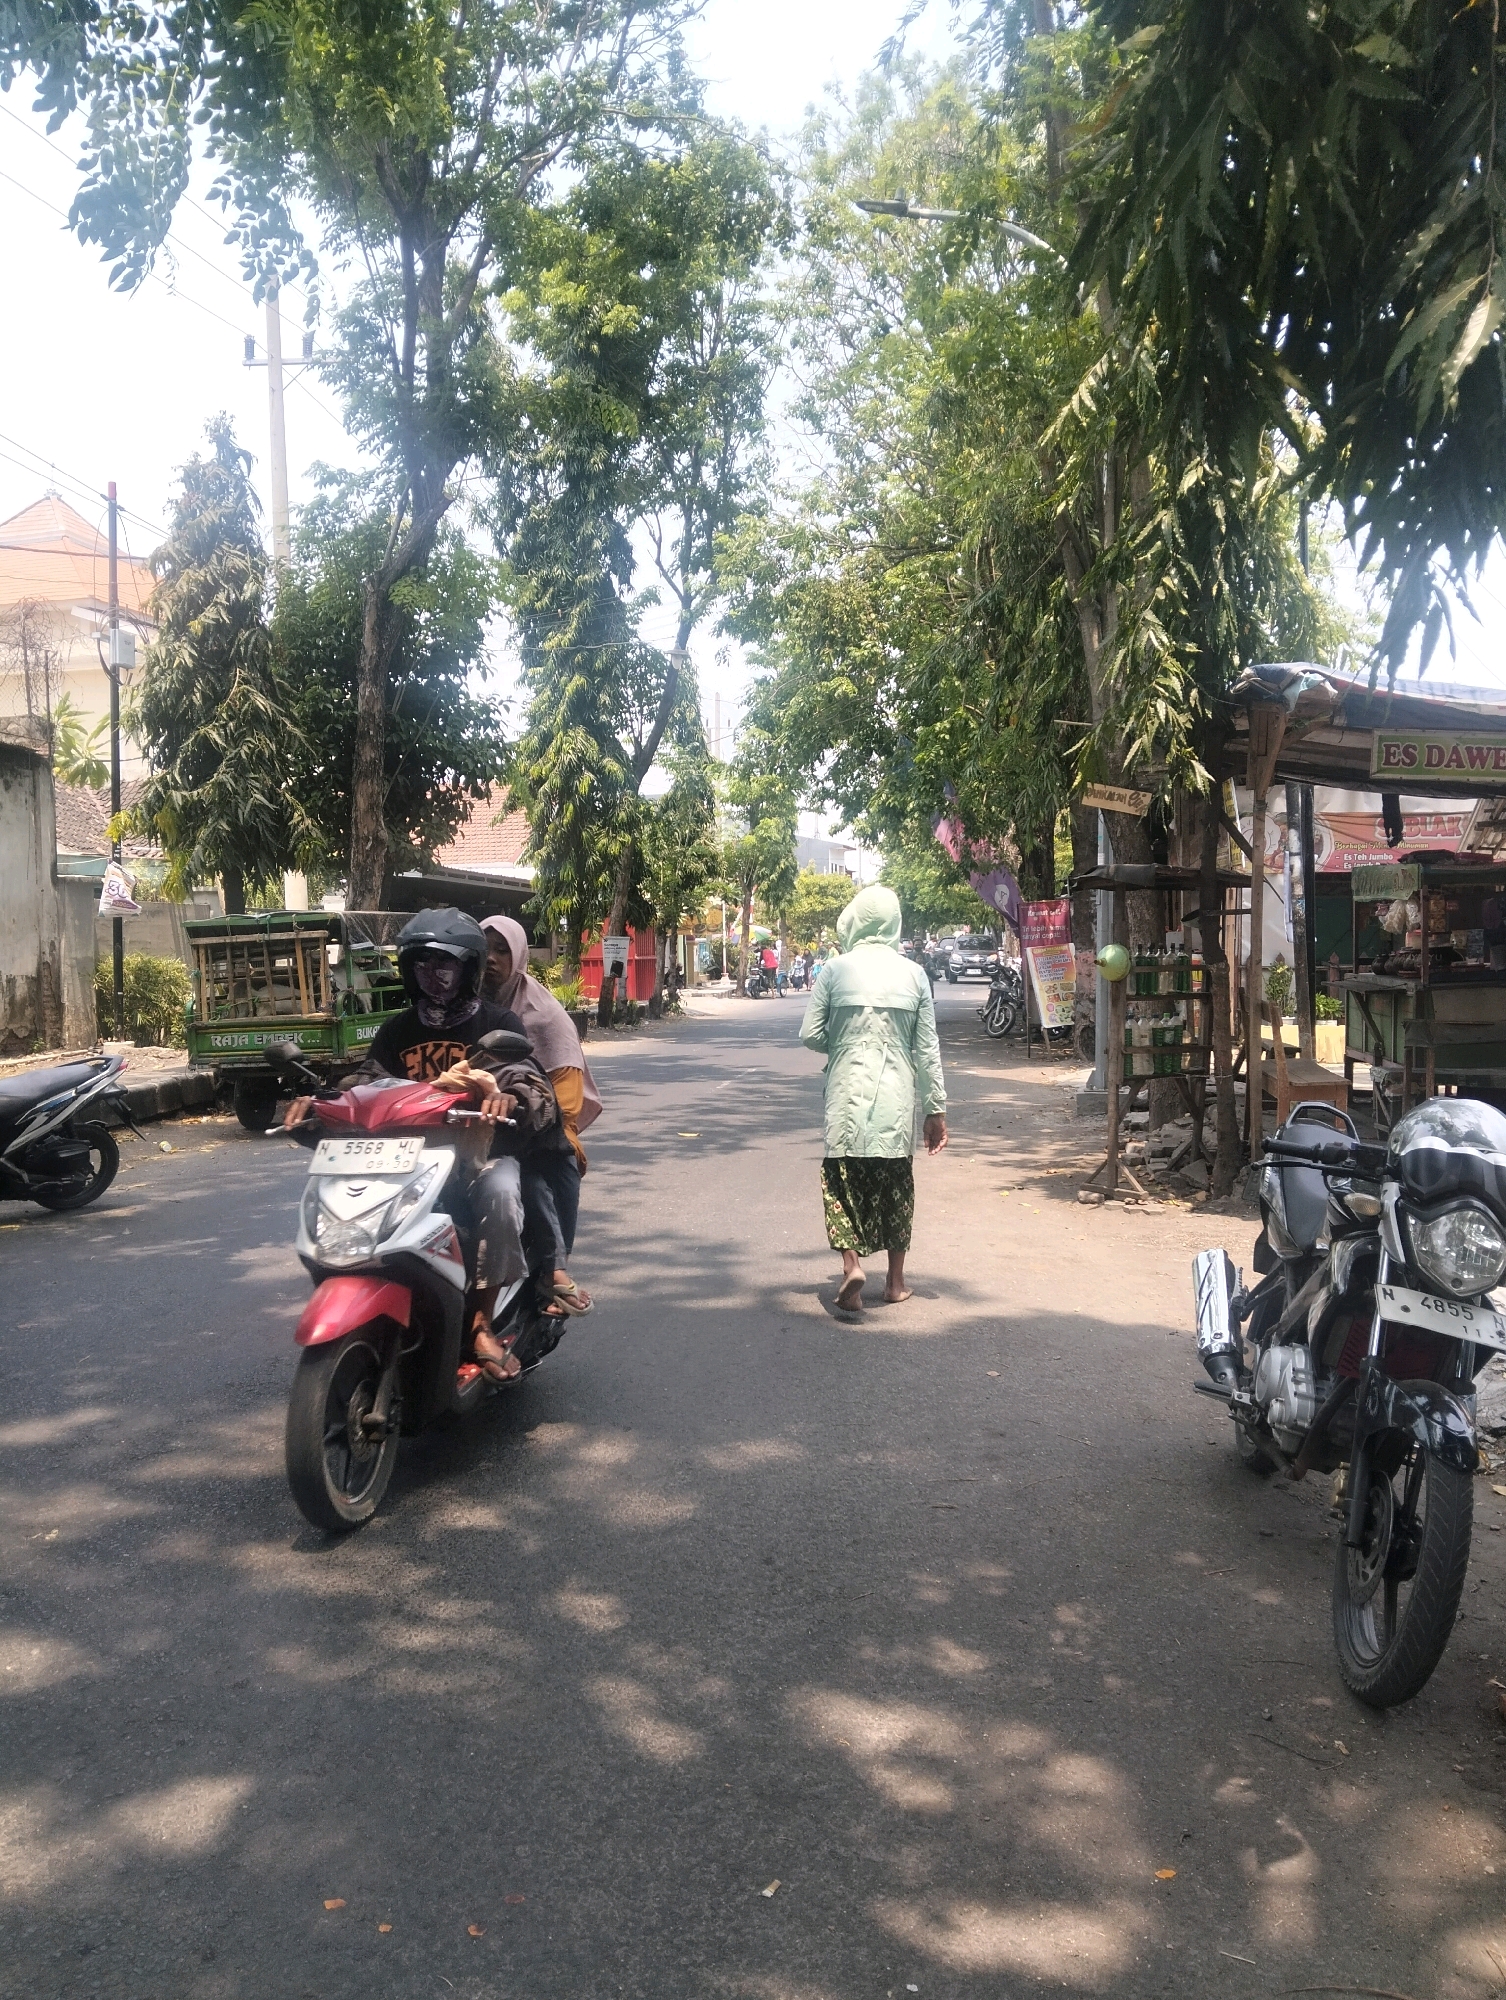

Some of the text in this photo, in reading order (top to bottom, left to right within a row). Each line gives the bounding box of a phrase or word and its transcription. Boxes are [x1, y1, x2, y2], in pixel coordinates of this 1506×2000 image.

[1381, 742, 1418, 768] ES
[1374, 816, 1463, 840] SBLAK
[1369, 841, 1390, 850] Men
[1343, 853, 1394, 861] Es Teh Jumbo
[1343, 862, 1352, 870] Es
[210, 1034, 249, 1048] RAJA
[254, 1032, 304, 1045] EMBEK
[356, 1025, 380, 1040] BUKA
[343, 1141, 386, 1155] 5568
[1420, 1296, 1475, 1321] 4855
